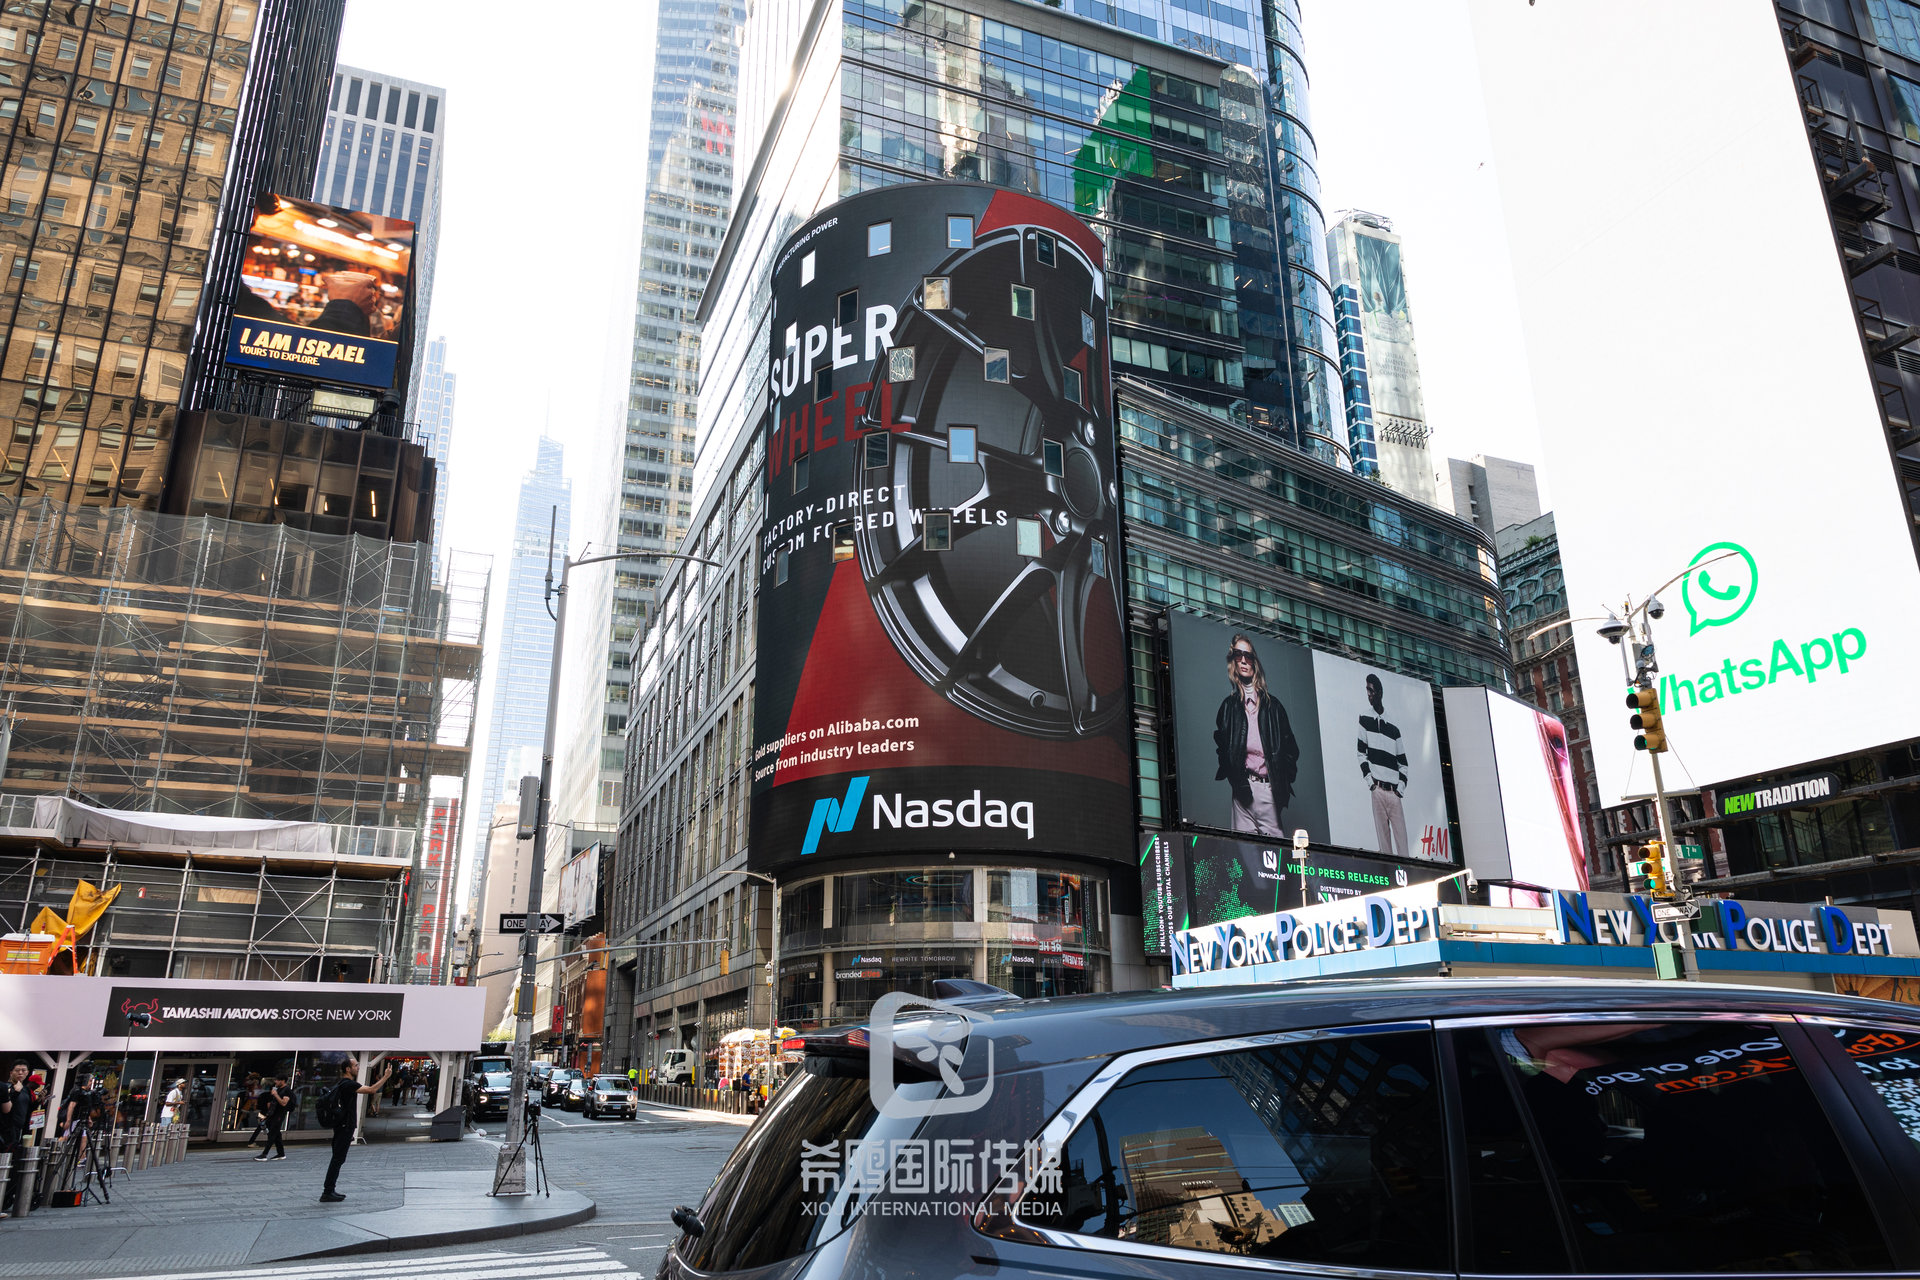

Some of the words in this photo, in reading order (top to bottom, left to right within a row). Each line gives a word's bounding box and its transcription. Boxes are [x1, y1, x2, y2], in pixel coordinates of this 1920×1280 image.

[811, 217, 838, 237] POWER
[240, 327, 251, 344] I
[253, 331, 292, 352] AM
[296, 337, 365, 364] ISRAEL
[240, 345, 267, 358] YOURS
[269, 349, 280, 359] TO
[281, 351, 320, 366] EXPLORE.
[770, 304, 898, 413] SUPER
[768, 379, 912, 485] WHEEL
[763, 484, 906, 552] FACTORY-DIRECT
[762, 532, 804, 575] CUSOM
[813, 511, 894, 543] FOGED
[766, 731, 806, 754] suppliers
[809, 727, 824, 739] on
[827, 717, 919, 736] Alibaba.com
[754, 763, 775, 782] Source
[775, 755, 798, 772] from
[800, 745, 854, 765] industry
[857, 739, 915, 755] leaders
[873, 790, 1034, 840] Nasdaq
[427, 807, 447, 867] PARK
[1421, 825, 1448, 860] H&M
[1287, 863, 1315, 876] VIDEO
[1318, 867, 1345, 881] PRESS
[1348, 872, 1390, 886] RELEASES
[1320, 885, 1354, 895] DISTRIBUTED
[507, 919, 524, 928] ONE
[540, 919, 552, 928] AY
[1552, 889, 1633, 945] NEW
[1717, 899, 1820, 953] POLICE
[1820, 905, 1893, 956] DEPT
[1657, 909, 1670, 917] ONE
[1677, 906, 1692, 914] WAY
[416, 904, 435, 966] PARK
[1171, 931, 1216, 975] NEW
[1215, 923, 1276, 969] YORK
[1276, 912, 1360, 961] POLICE
[1365, 896, 1440, 948] DEPT
[861, 956, 882, 964] Nasdaq
[1012, 956, 1034, 964] Nasdaq
[162, 1007, 221, 1019] TAMASHII
[282, 1008, 324, 1021] STORE
[326, 1010, 355, 1020] NEW
[357, 1010, 392, 1021] YORK
